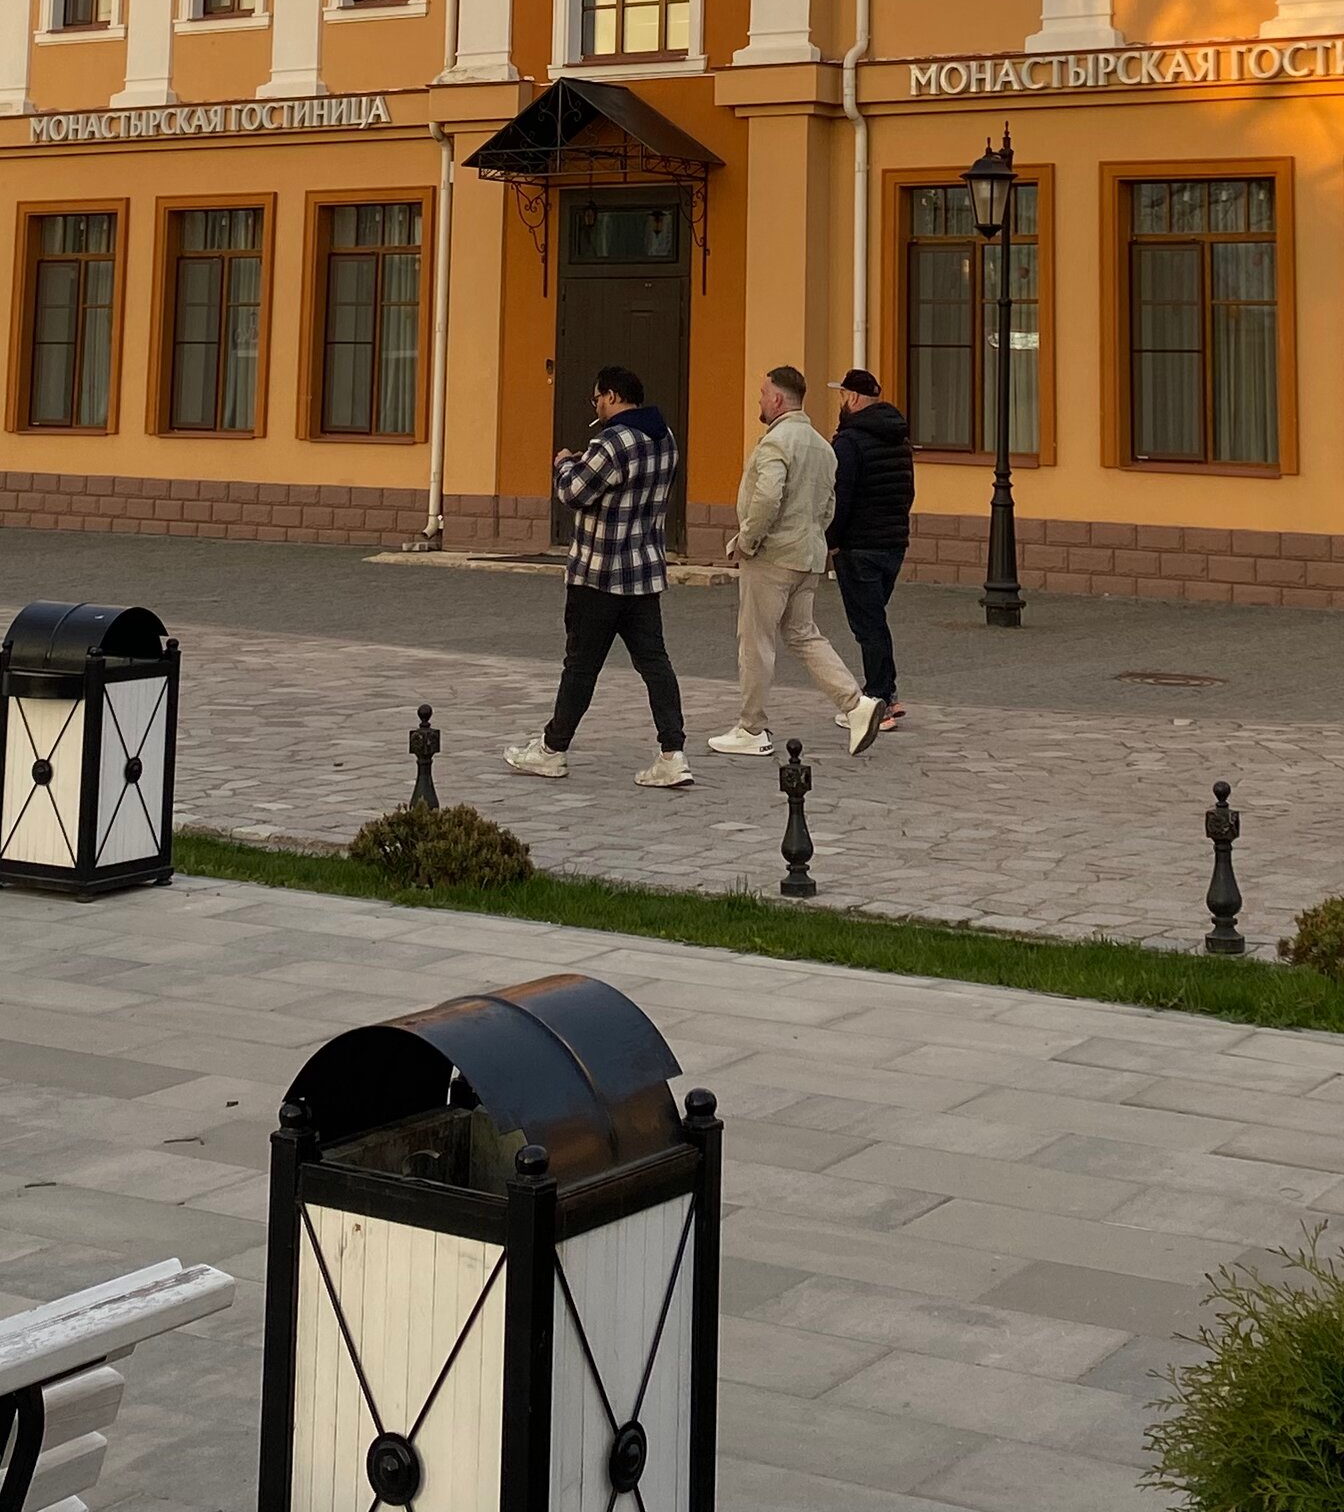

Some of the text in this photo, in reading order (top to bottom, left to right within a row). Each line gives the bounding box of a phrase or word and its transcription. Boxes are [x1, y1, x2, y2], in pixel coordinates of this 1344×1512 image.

[909, 50, 1218, 96] МОНАСТЫРСКАЯ
[30, 95, 391, 142] МОНАСТЫРСКАЯ ГОСТИНИЦА
